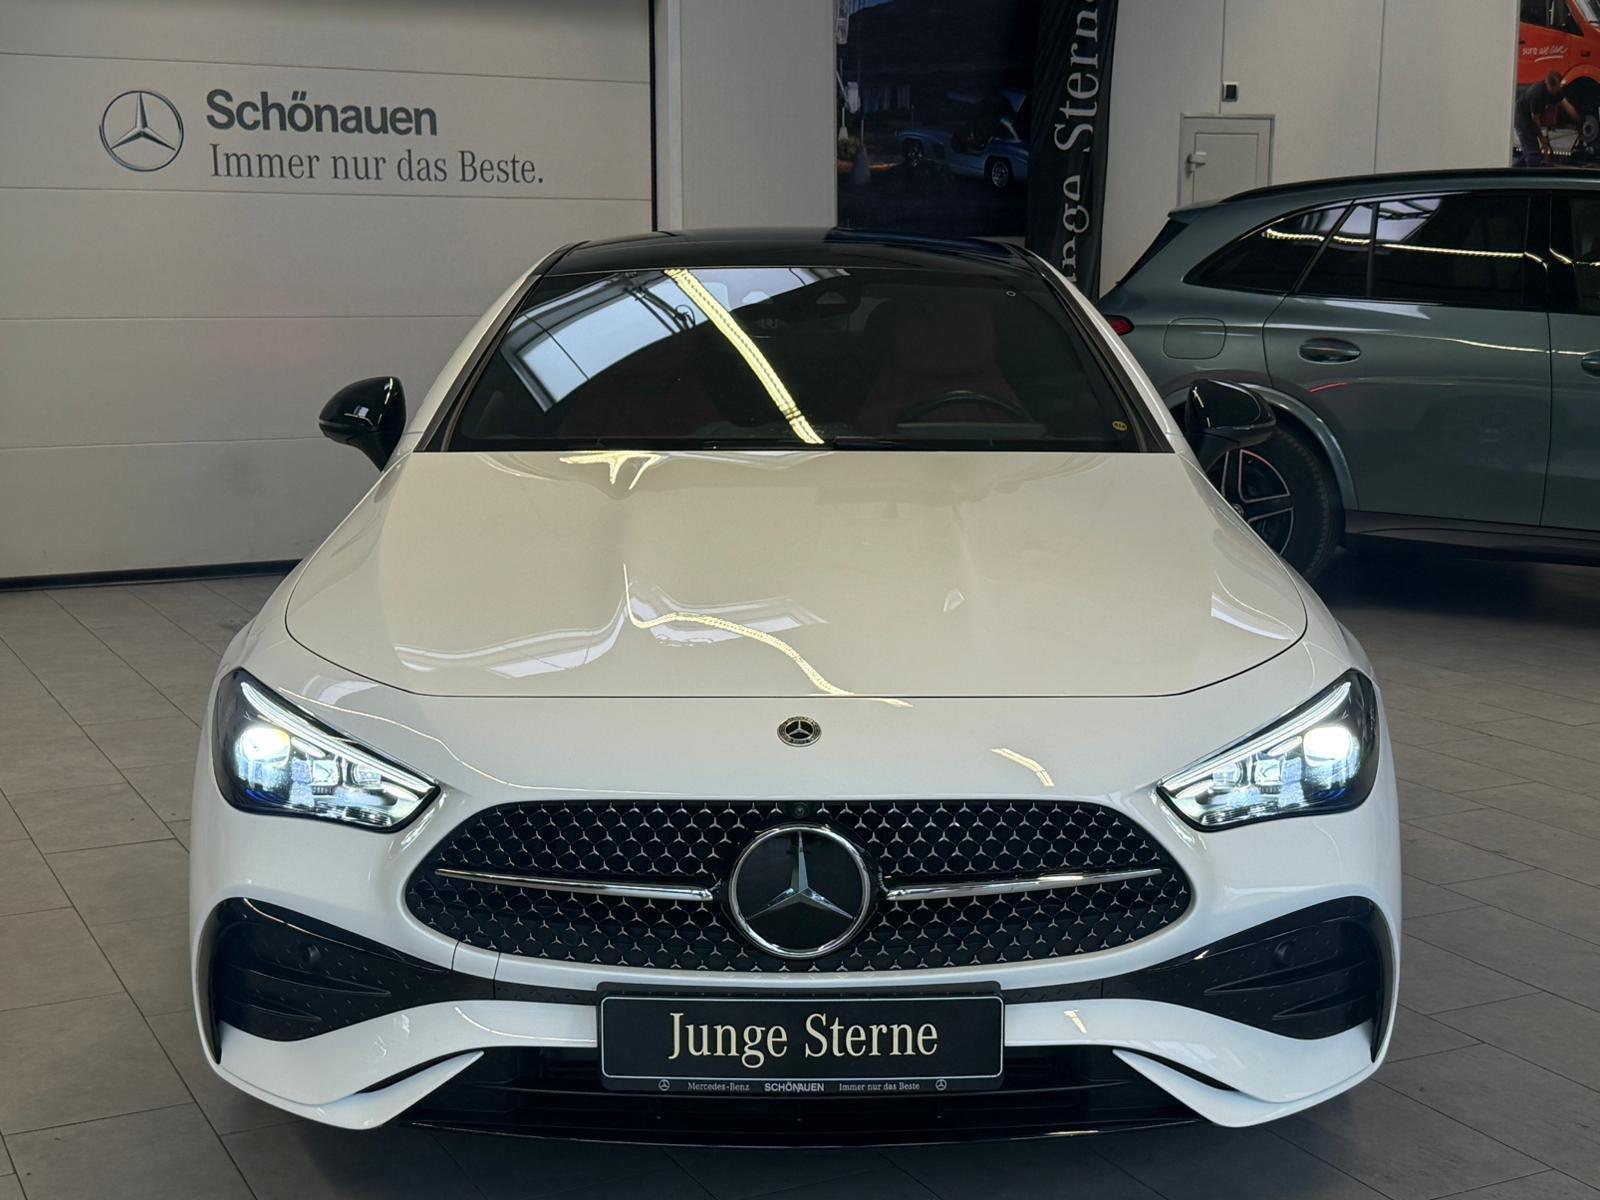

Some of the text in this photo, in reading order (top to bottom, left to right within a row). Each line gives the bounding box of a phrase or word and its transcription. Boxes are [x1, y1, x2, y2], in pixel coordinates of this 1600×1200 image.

[207, 88, 438, 136] Schönauen
[209, 143, 544, 184] Immer nur das Beste.
[1054, 0, 1099, 282] nge Stern
[668, 1012, 938, 1069] Junge Sterne
[687, 1080, 920, 1092] Mercedes-Benz SCHÖNAUEN Immer nur das Beste
